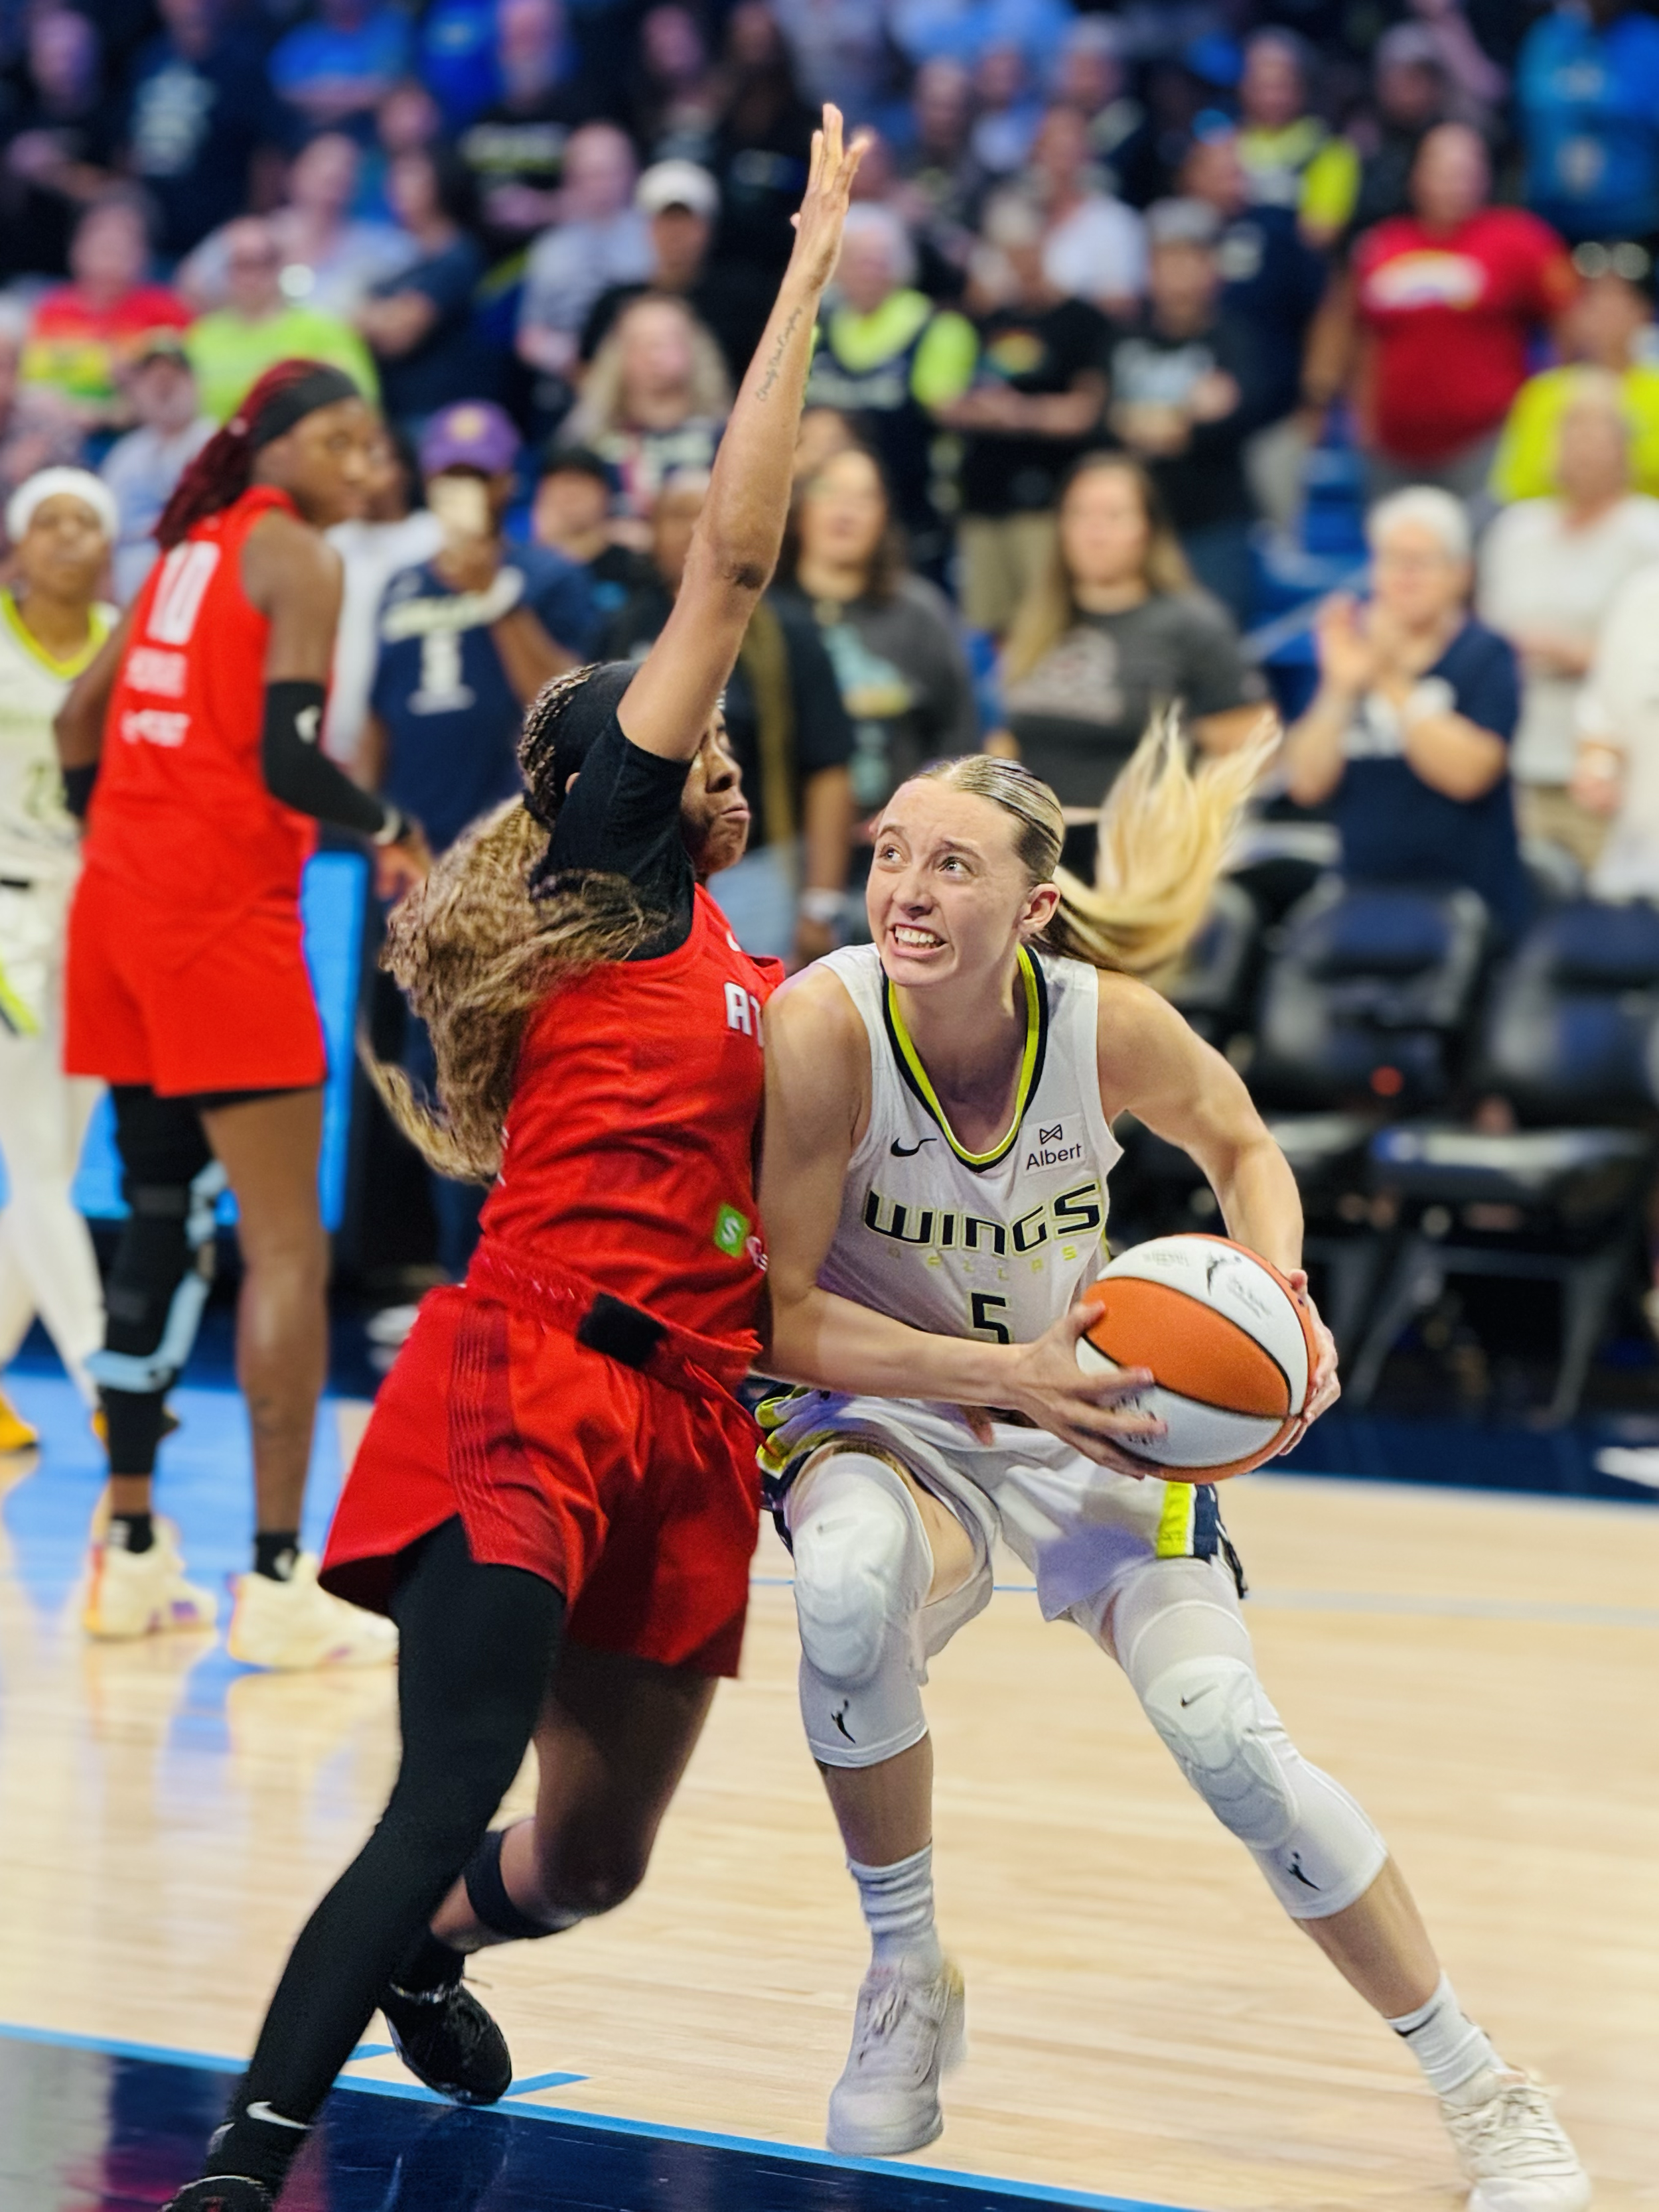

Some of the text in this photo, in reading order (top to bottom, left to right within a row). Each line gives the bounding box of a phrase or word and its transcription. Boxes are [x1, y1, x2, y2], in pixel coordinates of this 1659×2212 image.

[1026, 1143, 1082, 1170] Albert
[863, 1181, 1102, 1257] WINGS
[970, 1291, 1011, 1344] 5
